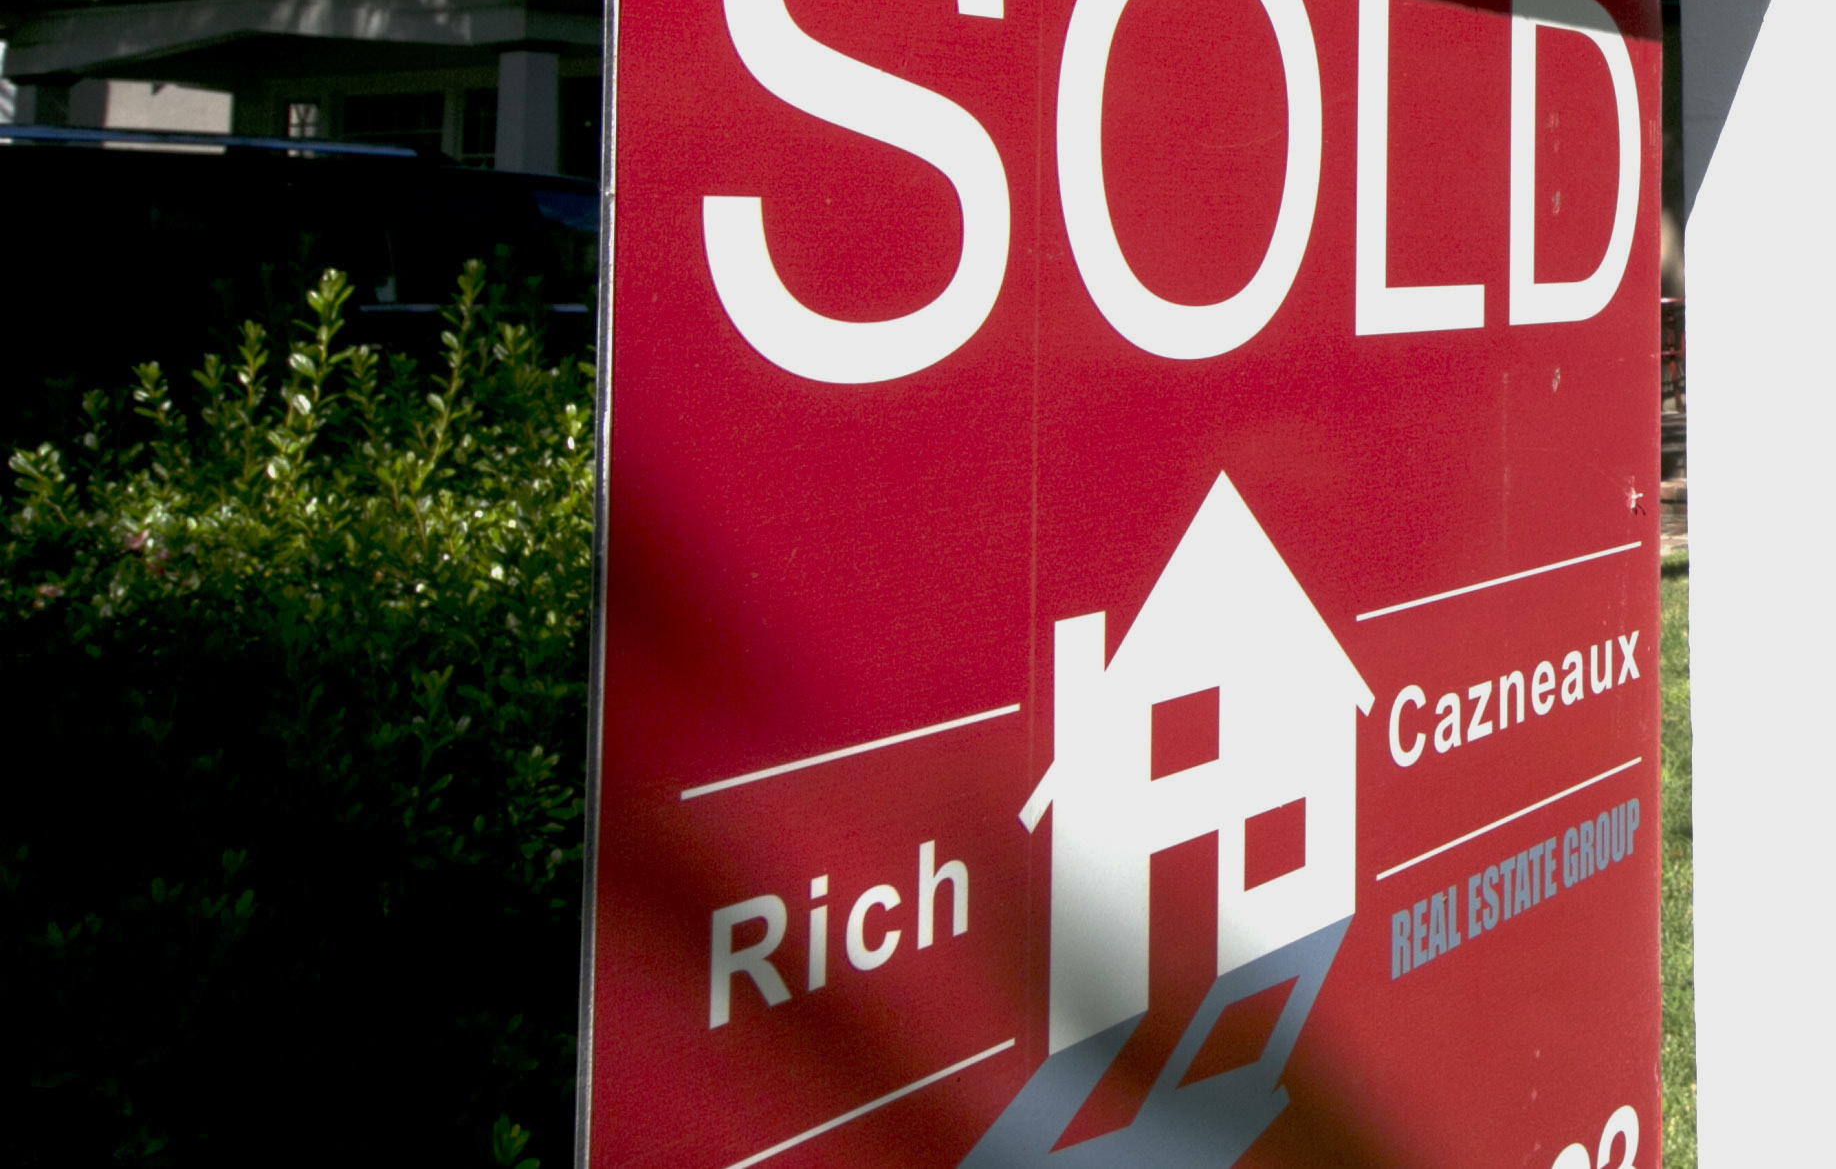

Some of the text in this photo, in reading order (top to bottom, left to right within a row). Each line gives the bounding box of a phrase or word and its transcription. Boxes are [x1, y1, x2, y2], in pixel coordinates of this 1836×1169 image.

[1388, 631, 1641, 767] Cazneaux
[709, 840, 969, 1029] Rich
[1391, 797, 1640, 980] REAL ESTATE GROUP
